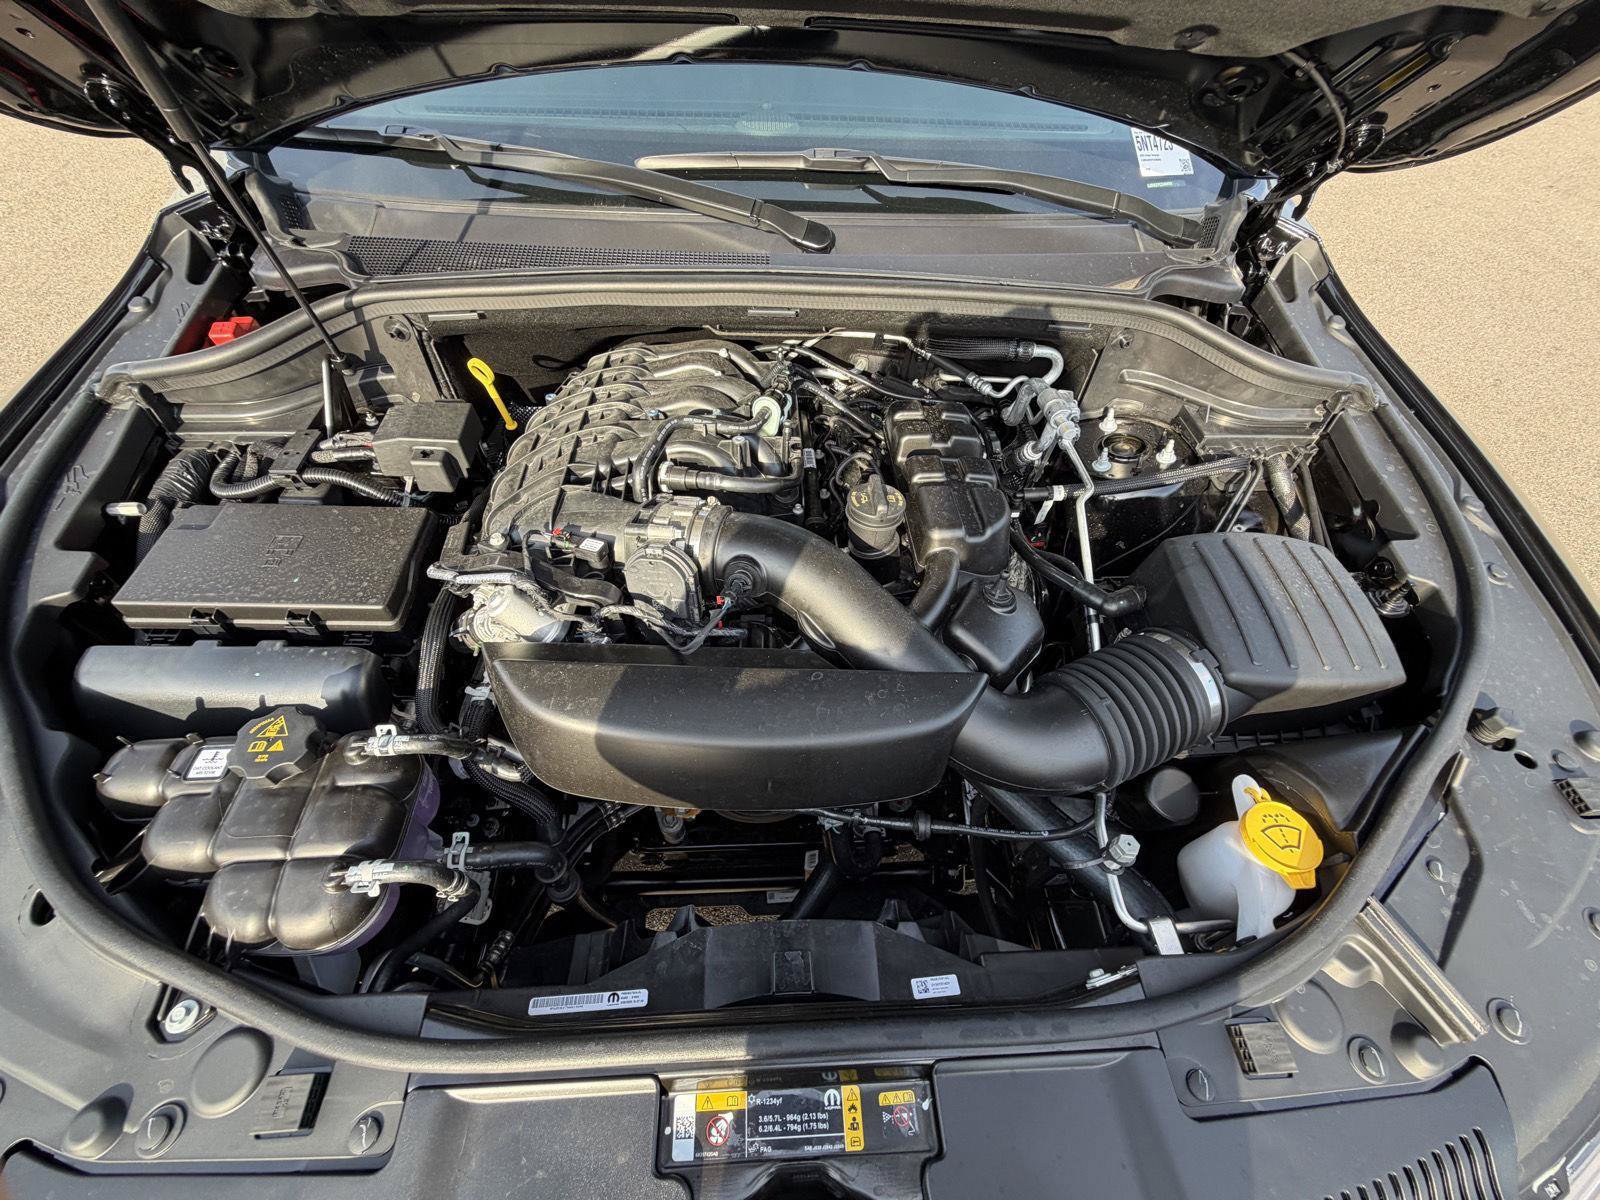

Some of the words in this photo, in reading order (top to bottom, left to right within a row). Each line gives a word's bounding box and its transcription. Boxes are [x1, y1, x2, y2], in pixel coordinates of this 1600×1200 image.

[756, 1097, 782, 1106] R-1234yf
[802, 1112, 816, 1121] (2.13
[818, 1112, 829, 1120] lbs)
[803, 1123, 817, 1132] (1.75
[818, 1122, 829, 1130] lbs)
